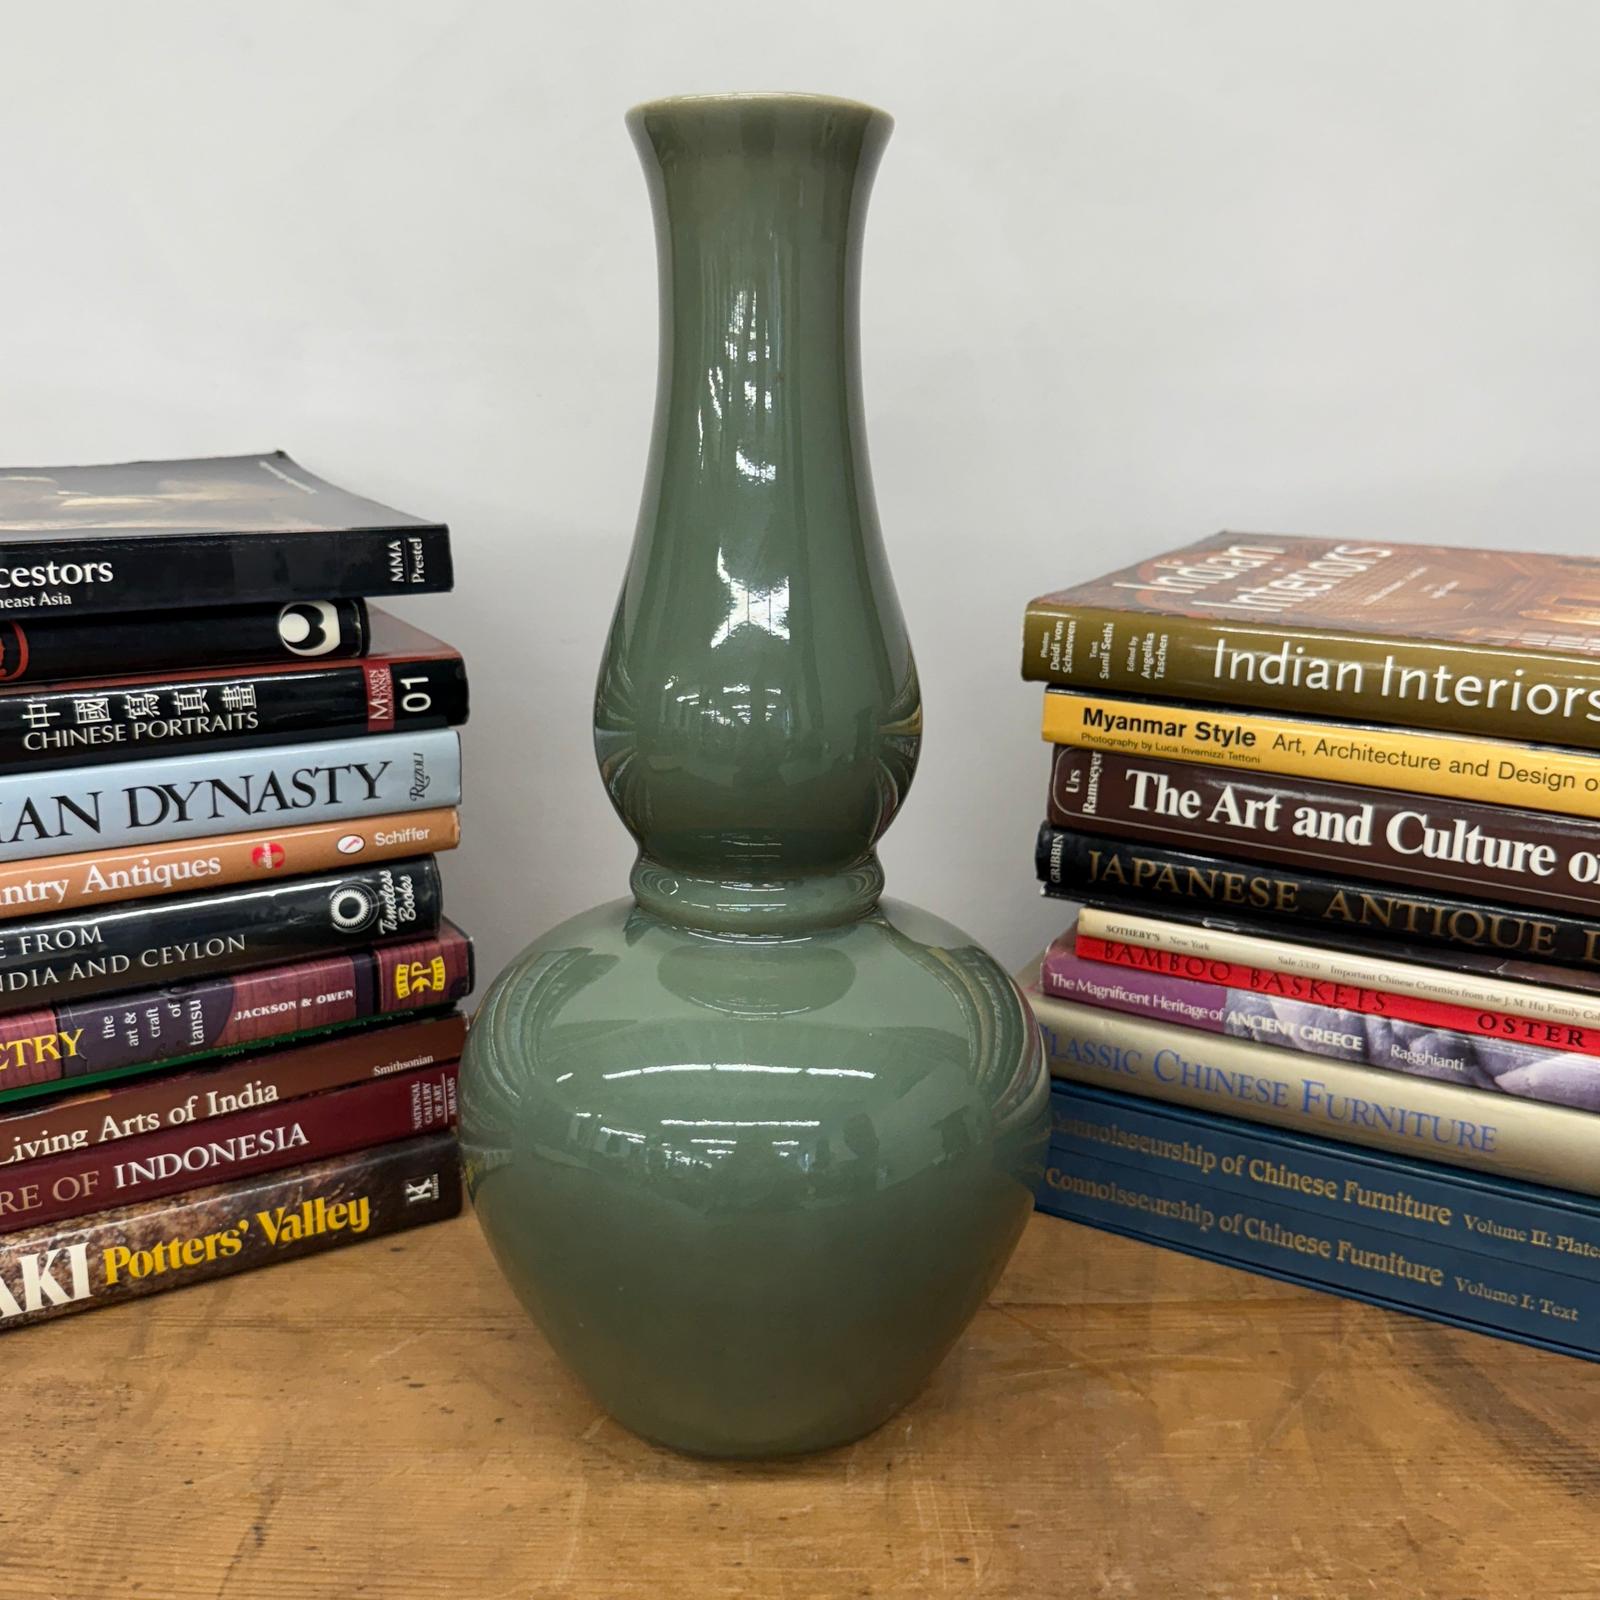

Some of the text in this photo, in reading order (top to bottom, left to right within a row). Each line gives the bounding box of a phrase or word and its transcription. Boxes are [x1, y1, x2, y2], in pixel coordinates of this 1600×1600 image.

[388, 540, 405, 582] MMA
[407, 537, 425, 583] Prestel
[1112, 544, 1286, 595] Indian
[1191, 545, 1393, 613] Interiors
[0, 591, 72, 608] east Asia
[1041, 632, 1049, 658] Photos
[1050, 621, 1064, 671] Deidi von
[1063, 621, 1076, 673] Schaewen
[1090, 641, 1098, 658] Text
[1099, 623, 1114, 679] Sunil Sethi
[1126, 635, 1139, 672] Edited by
[1141, 632, 1155, 679] Angelika
[1154, 634, 1168, 679] Taschen
[400, 676, 432, 712] 01
[1214, 639, 1600, 722] Indian Interiors
[24, 712, 259, 750] CHINESE PORTRAITS
[1081, 732, 1260, 764] Photography by Luca Invernizzi Tettoni
[1083, 707, 1187, 737] Myanmar
[1194, 721, 1256, 748] Style
[1272, 733, 1306, 756] Art,
[1314, 738, 1441, 771] Architecture
[1449, 759, 1489, 777] and
[1498, 761, 1576, 792] Design
[0, 761, 392, 844] AN DYNASTY
[1065, 769, 1081, 793] Urs
[1082, 750, 1102, 814] Ramseyer
[375, 828, 430, 846] Schiffer
[1125, 769, 1200, 819] The
[1206, 784, 1282, 832] Art
[1292, 803, 1374, 847] and
[1386, 811, 1557, 876] Culture
[0, 857, 222, 906] ntry Antiques
[1050, 833, 1064, 883] GRIBBIN
[379, 869, 398, 934] Timeless
[398, 874, 416, 922] Books
[1087, 850, 1299, 912] JAPANESE
[1321, 889, 1558, 955] ANTIQUE
[19, 926, 104, 955] FROM
[69, 954, 130, 981] AND
[141, 935, 246, 967] CEYLON
[1103, 940, 1585, 1048] BAMBOO BASKETS OSTER
[1106, 925, 1160, 941] SOTHEBY'S
[1169, 935, 1188, 946] New
[1190, 938, 1210, 951] York
[1278, 955, 1296, 966] Sale
[1330, 965, 1376, 982] Important
[1378, 973, 1414, 988] Chinese
[1416, 980, 1459, 996] Ceramics
[1461, 988, 1484, 1001] from
[1486, 993, 1501, 1003] the
[1529, 1001, 1544, 1012] Hu
[1547, 1003, 1580, 1018] Family
[103, 1015, 115, 1040] the
[124, 1012, 139, 1047] art &
[146, 1006, 161, 1038] craft
[168, 1003, 181, 1018] of
[190, 999, 205, 1047] tansu
[234, 989, 354, 1022] JACKSON & OWEN
[1051, 972, 1363, 1051] The Magnificent Heritage of ANCIENT GREECE
[373, 1055, 434, 1076] Smithsonian
[1390, 1044, 1465, 1071] Ragghianti
[98, 1115, 160, 1142] Arts
[169, 1095, 199, 1125] of
[207, 1080, 279, 1116] India
[411, 1081, 422, 1129] NATIONAL
[422, 1082, 433, 1124] GALLERY
[433, 1084, 443, 1118] OF ART
[1153, 1048, 1289, 1108] CHINESE
[1300, 1079, 1498, 1152] FURNITURE
[52, 1170, 100, 1201] OF
[114, 1122, 310, 1189] INDONESIA
[1221, 1154, 1246, 1176] of
[1249, 1159, 1338, 1200] Chinese
[1344, 1180, 1453, 1225] Furniture
[1464, 1213, 1527, 1241] Volume
[1531, 1229, 1551, 1248] II:
[1556, 1235, 1600, 1258] Plate
[102, 1219, 250, 1286] Potters'
[256, 1196, 371, 1246] Valley
[1046, 1167, 1214, 1232] Connoisseurship
[1219, 1213, 1243, 1234] of
[1244, 1218, 1331, 1258] Chinese
[1336, 1239, 1445, 1287] Furniture
[1454, 1276, 1518, 1305] Volume
[1539, 1298, 1579, 1321] Text
